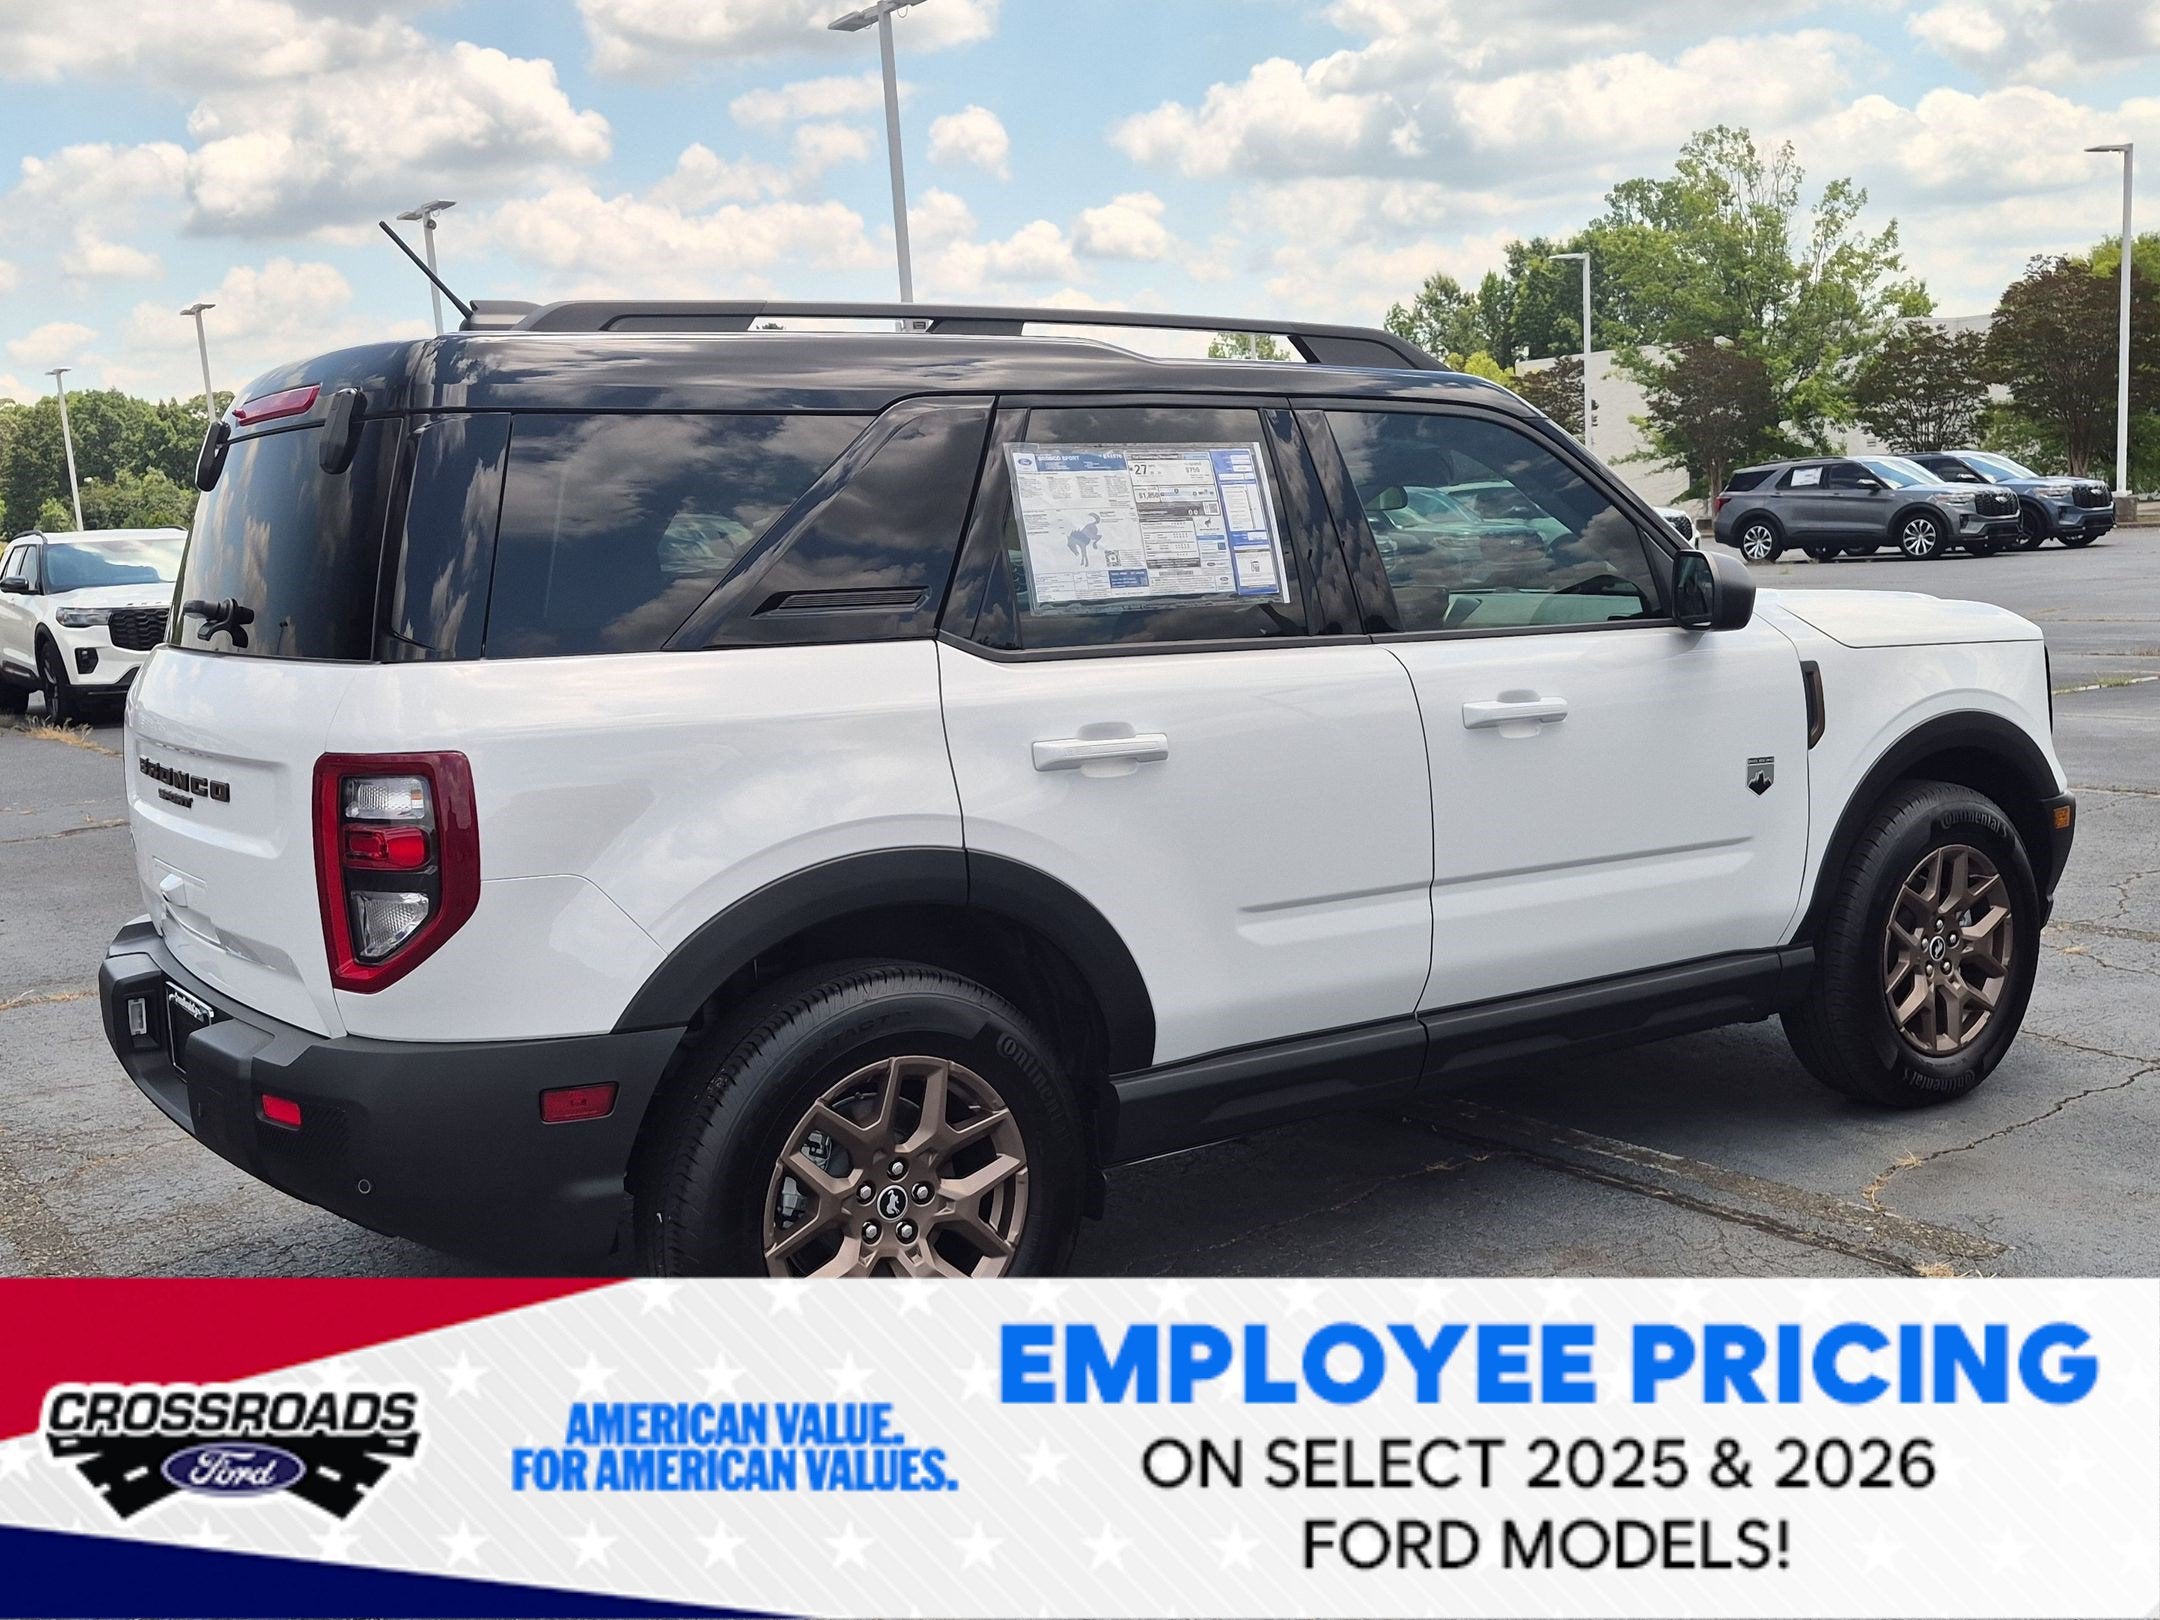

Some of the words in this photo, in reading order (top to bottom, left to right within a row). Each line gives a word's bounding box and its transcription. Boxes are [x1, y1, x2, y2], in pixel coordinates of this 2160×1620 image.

[1134, 464, 1147, 475] 27
[139, 756, 231, 803] BRONCO
[995, 1030, 1074, 1145] Continent
